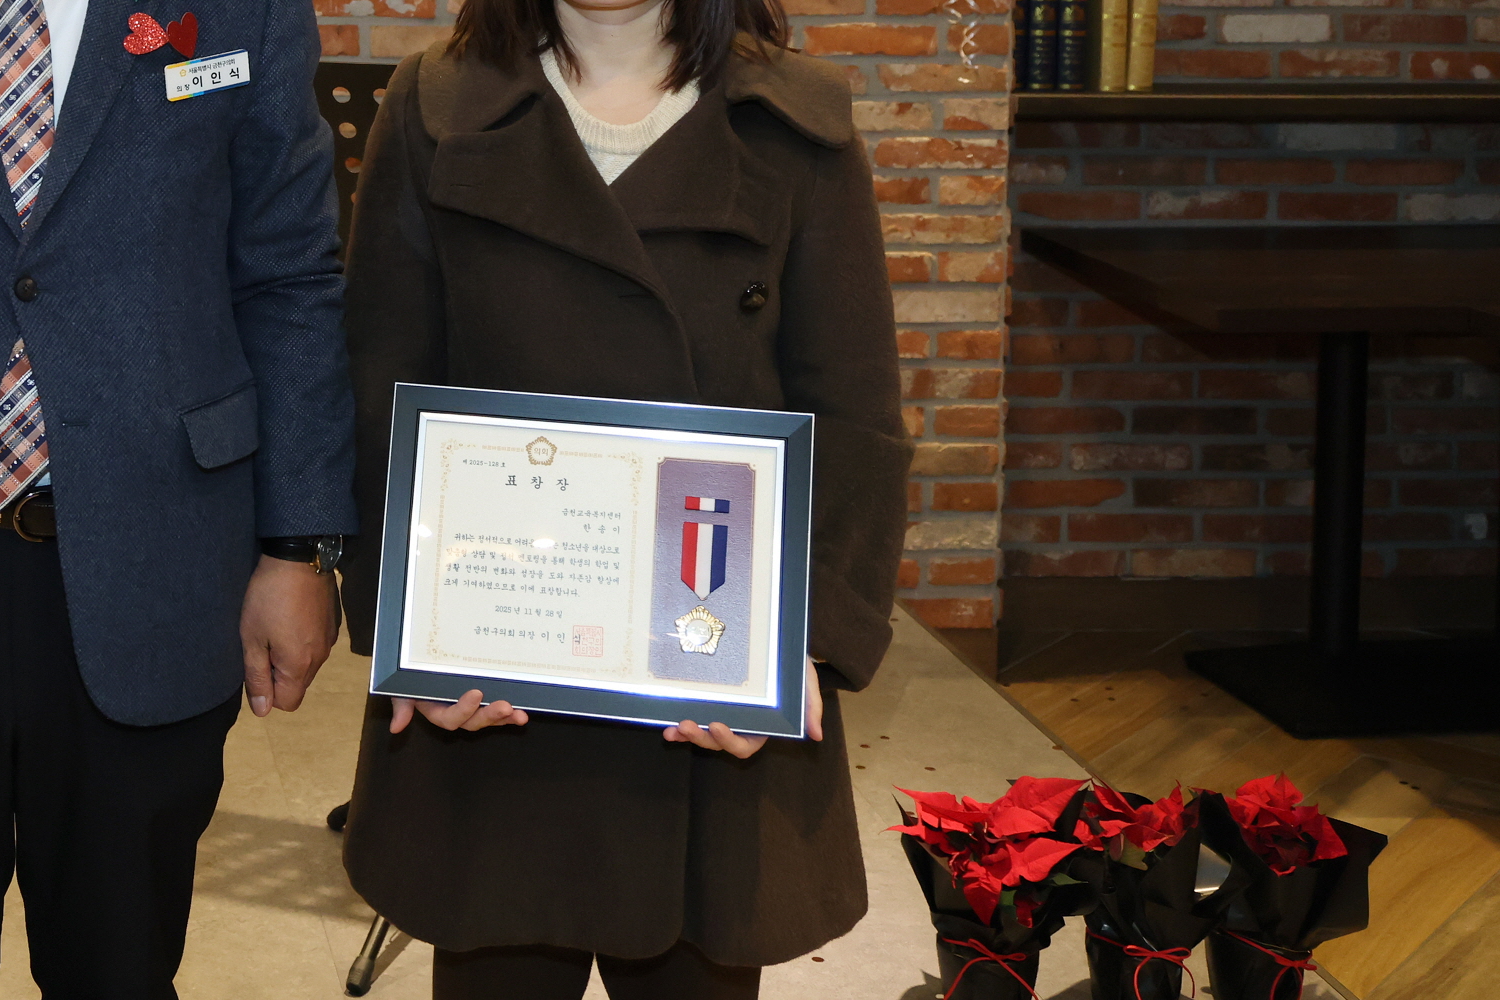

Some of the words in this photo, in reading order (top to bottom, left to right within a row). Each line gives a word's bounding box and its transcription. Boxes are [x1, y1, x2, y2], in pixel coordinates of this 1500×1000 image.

[454, 533, 475, 542] 귀하는
[521, 584, 535, 593] 이에
[474, 626, 515, 637] 금천구의회
[519, 630, 535, 640] 의장
